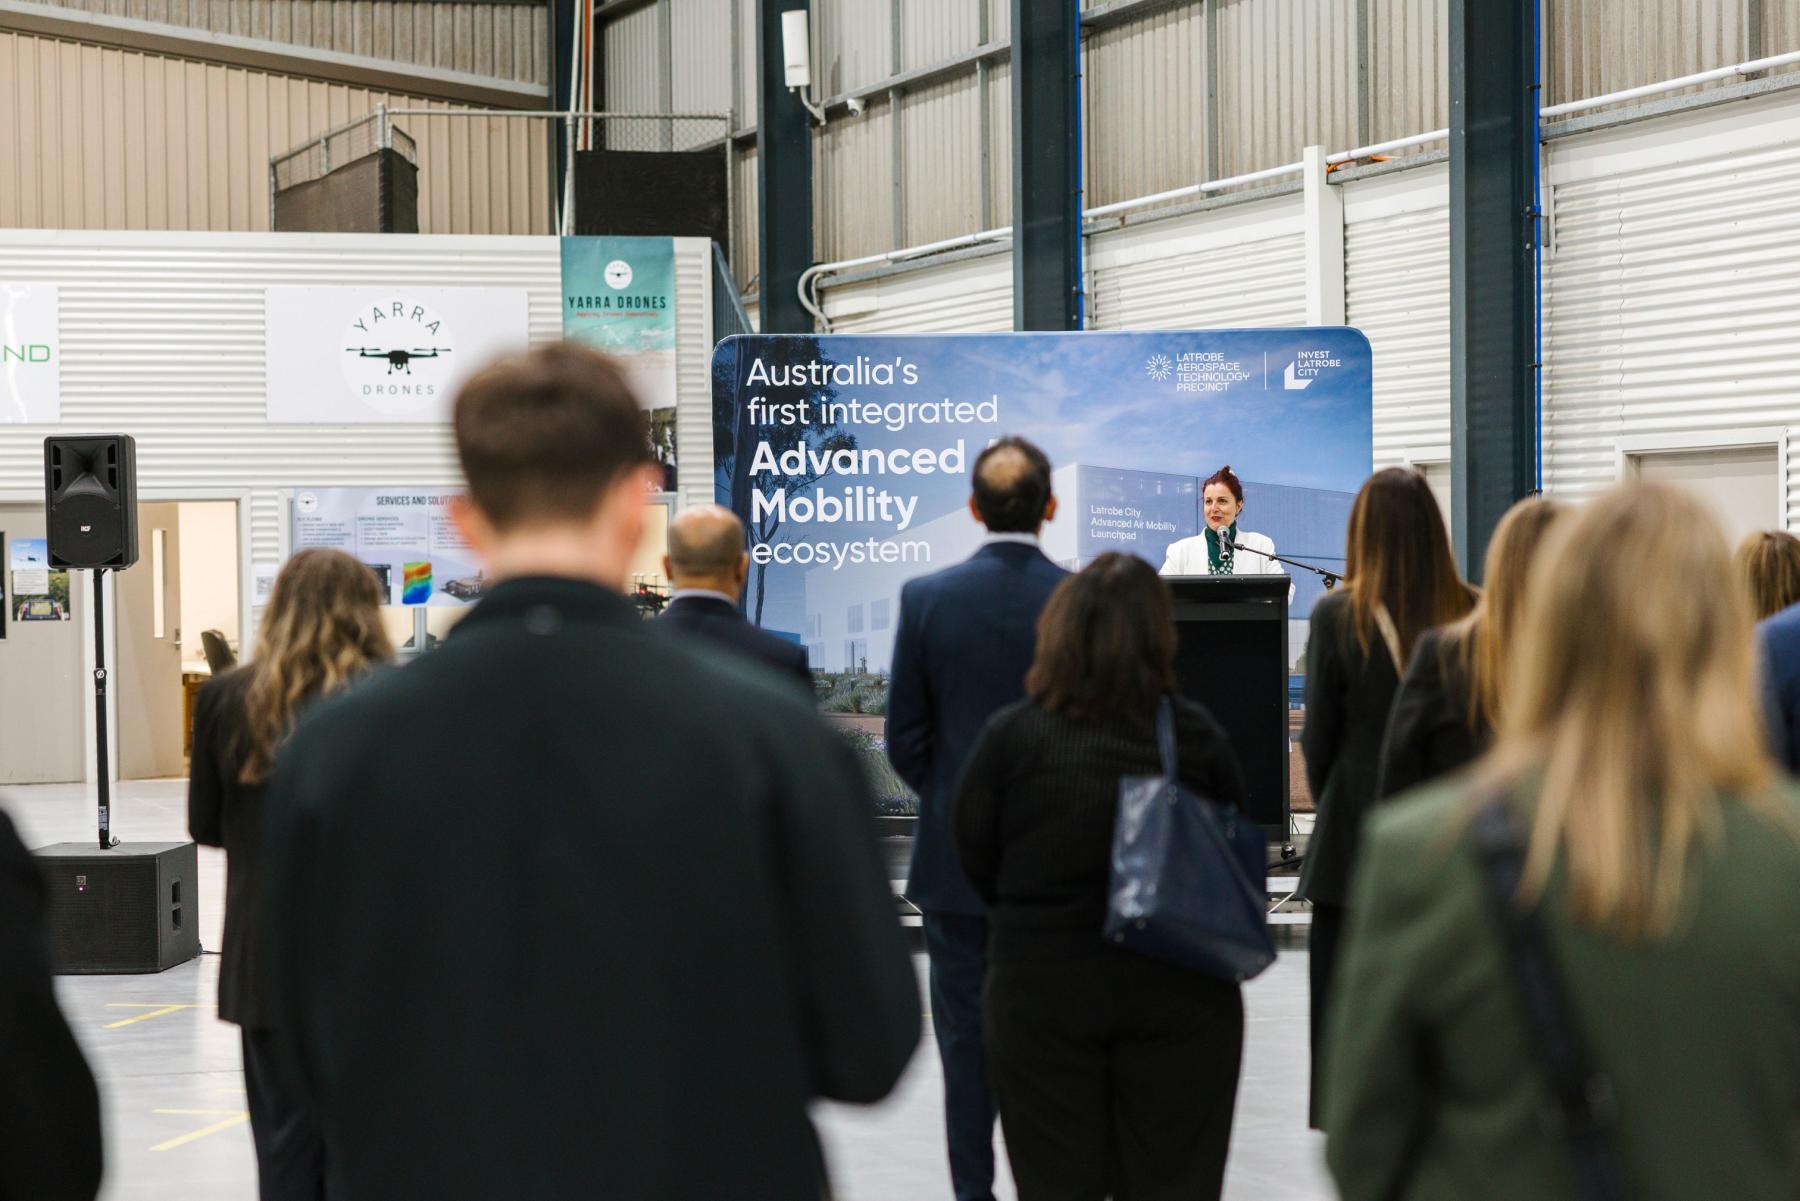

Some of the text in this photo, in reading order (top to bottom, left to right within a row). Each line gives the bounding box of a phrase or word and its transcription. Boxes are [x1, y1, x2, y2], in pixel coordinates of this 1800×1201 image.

[568, 296, 667, 309] YARRA DRONES
[353, 301, 440, 335] YARRA
[1176, 352, 1225, 362] LATROBE
[1297, 351, 1330, 359] INVEST
[1176, 362, 1241, 372] AEROSPACE
[1297, 359, 1341, 368] LATROBE
[746, 356, 919, 387] Australia's
[1177, 372, 1250, 382] TECHNOLOGY
[1297, 368, 1320, 376] CITY
[362, 384, 435, 395] DRONES
[1177, 382, 1230, 392] PRECINCT
[747, 394, 999, 431] first integrated
[749, 439, 966, 477] Advanced
[376, 496, 410, 506] SERVICES
[411, 496, 426, 506] AND
[751, 485, 919, 530] Mobility
[1091, 505, 1141, 519] Latrobe City
[1091, 517, 1177, 533] Advanced Air Mobility
[1091, 528, 1137, 542] Launchpad
[751, 537, 931, 571] ecosystem
